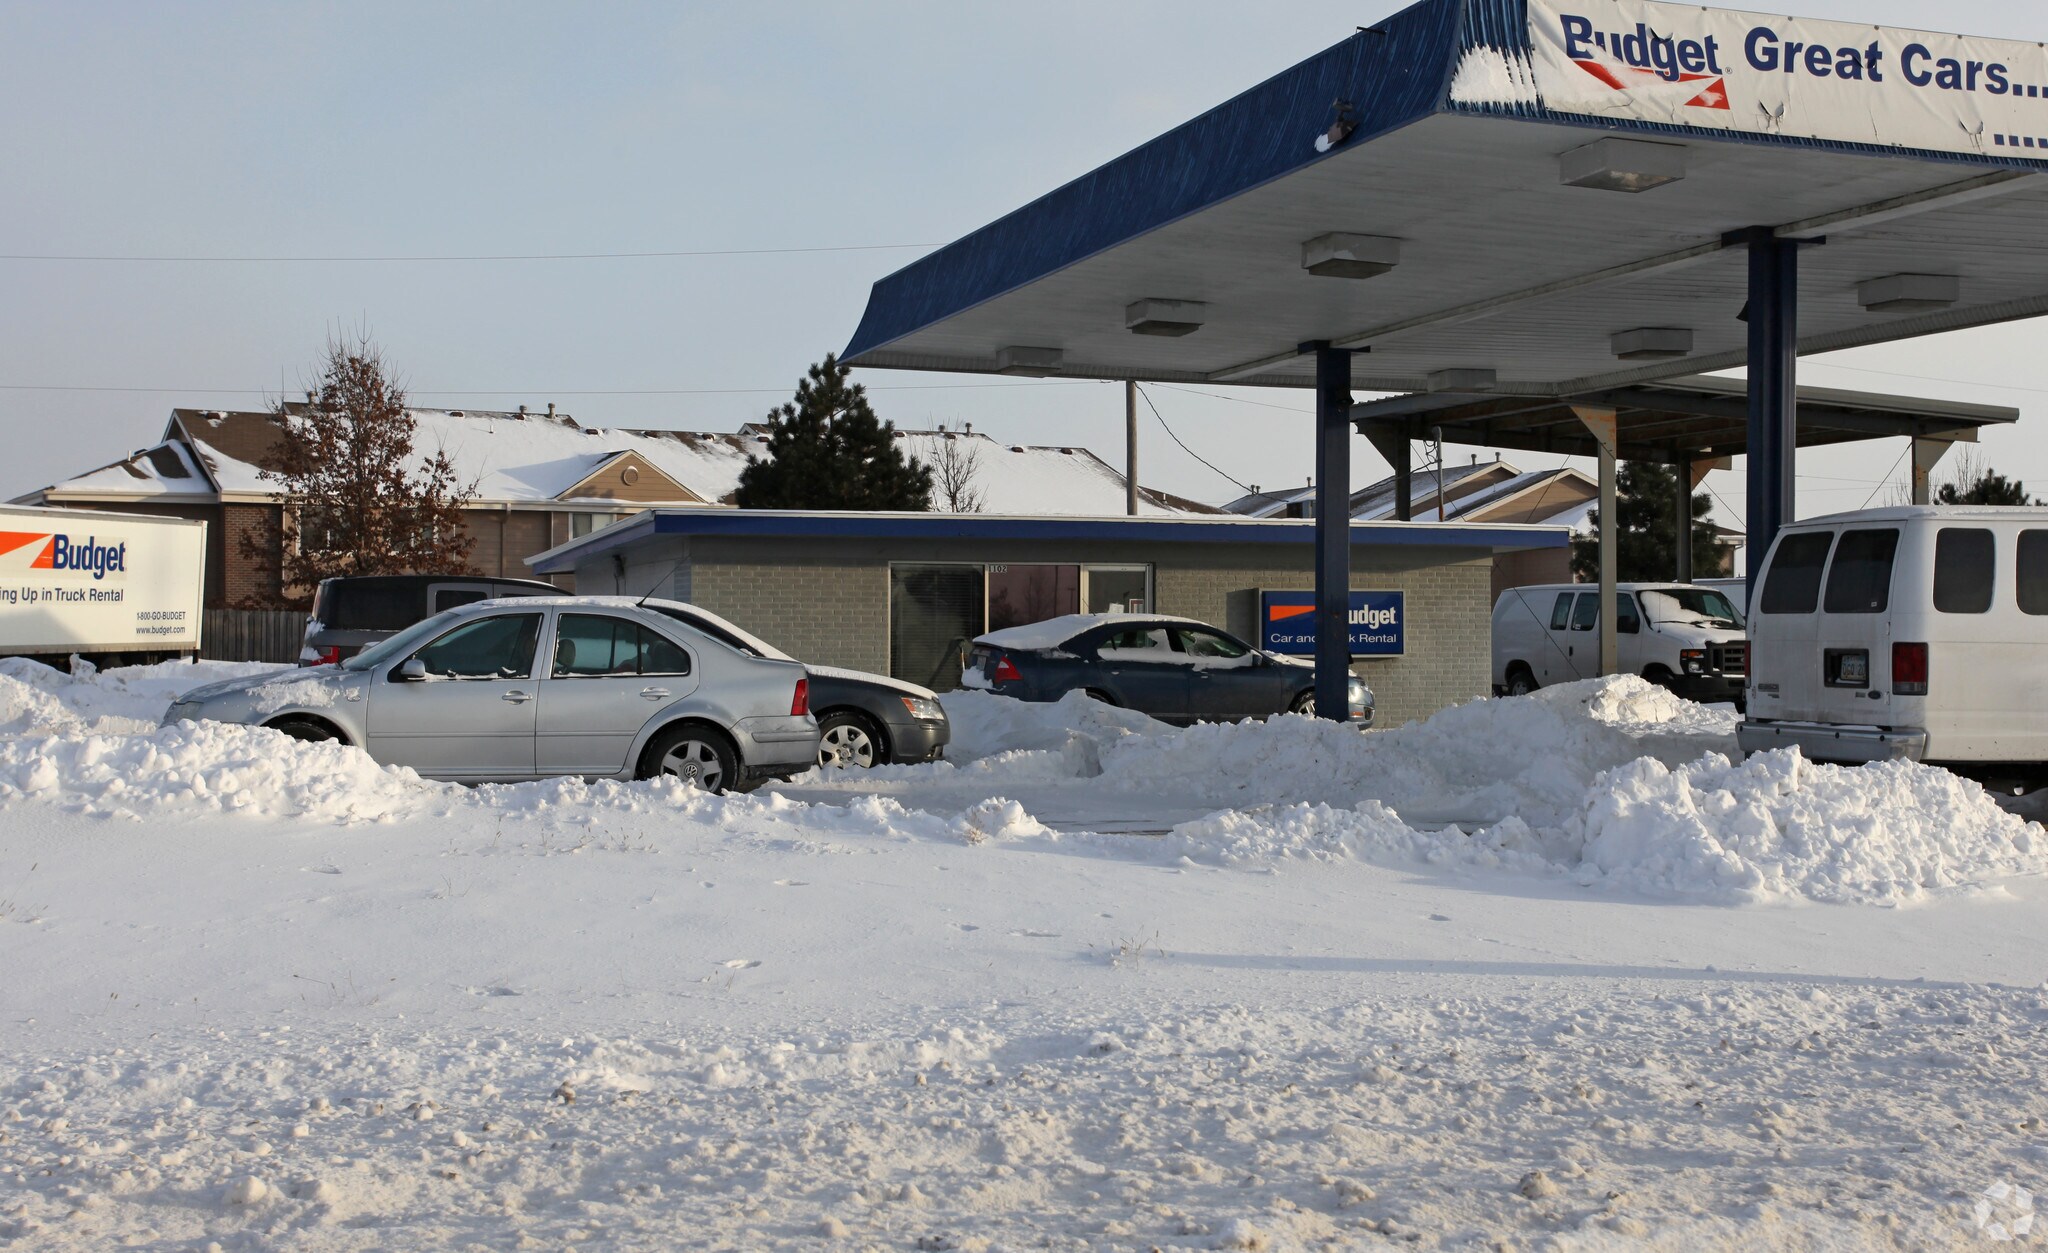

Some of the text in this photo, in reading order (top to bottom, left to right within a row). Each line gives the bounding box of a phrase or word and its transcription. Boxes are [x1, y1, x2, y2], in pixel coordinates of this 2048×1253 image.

[1744, 26, 1882, 82] Great
[53, 533, 126, 580] Budget
[21, 587, 38, 604] Up
[41, 588, 53, 601] in
[55, 588, 86, 602] Truck
[89, 588, 124, 602] Rental
[136, 611, 186, 620] 1-800-GO-BUDGET
[1348, 604, 1396, 630] udget
[136, 626, 186, 635] www.budget.com
[1270, 633, 1293, 643] Car
[1359, 633, 1397, 643] Rental
